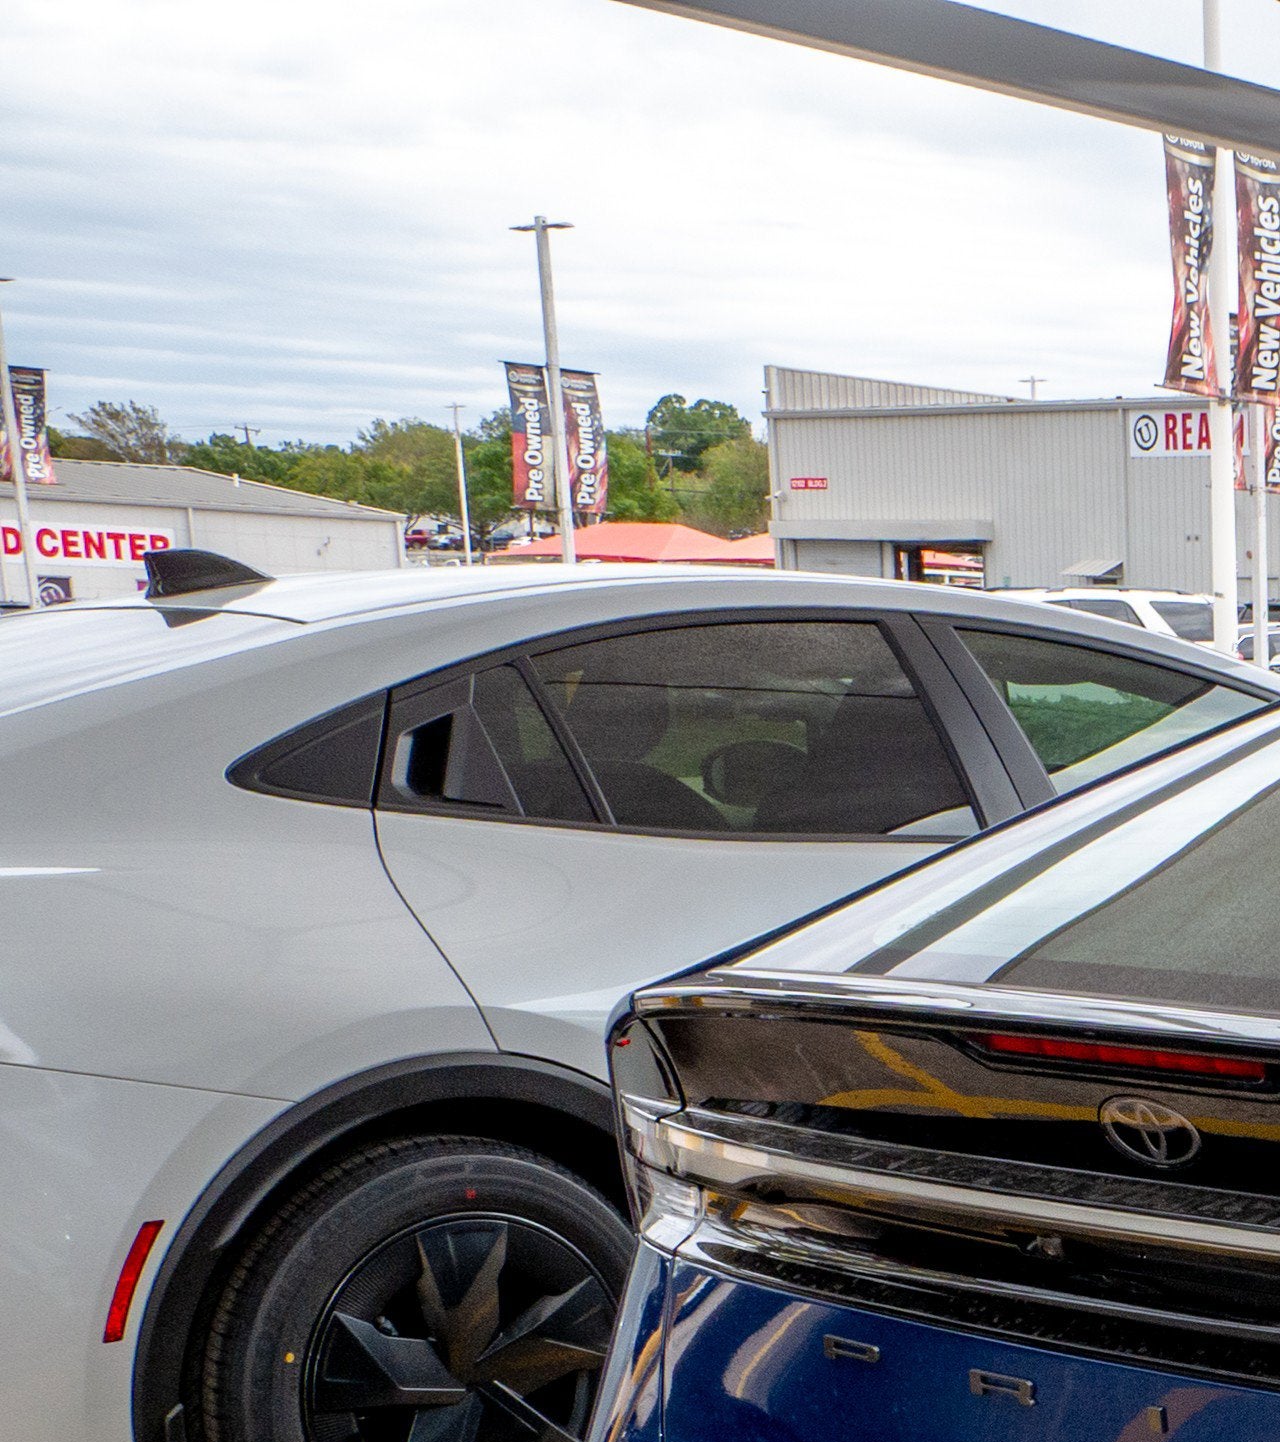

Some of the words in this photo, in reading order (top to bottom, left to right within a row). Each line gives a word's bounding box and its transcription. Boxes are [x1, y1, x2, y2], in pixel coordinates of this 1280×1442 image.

[1180, 138, 1205, 151] TOYOTA
[1251, 155, 1276, 170] TOYOTA
[1184, 177, 1204, 304] Vehicles
[1181, 314, 1204, 381] New
[1251, 323, 1280, 391] New
[16, 393, 37, 450] Owned
[519, 397, 543, 466] Owned
[571, 402, 596, 470] Owned
[25, 453, 49, 479] Pre
[525, 469, 544, 502] Pre
[576, 472, 596, 506] Pre
